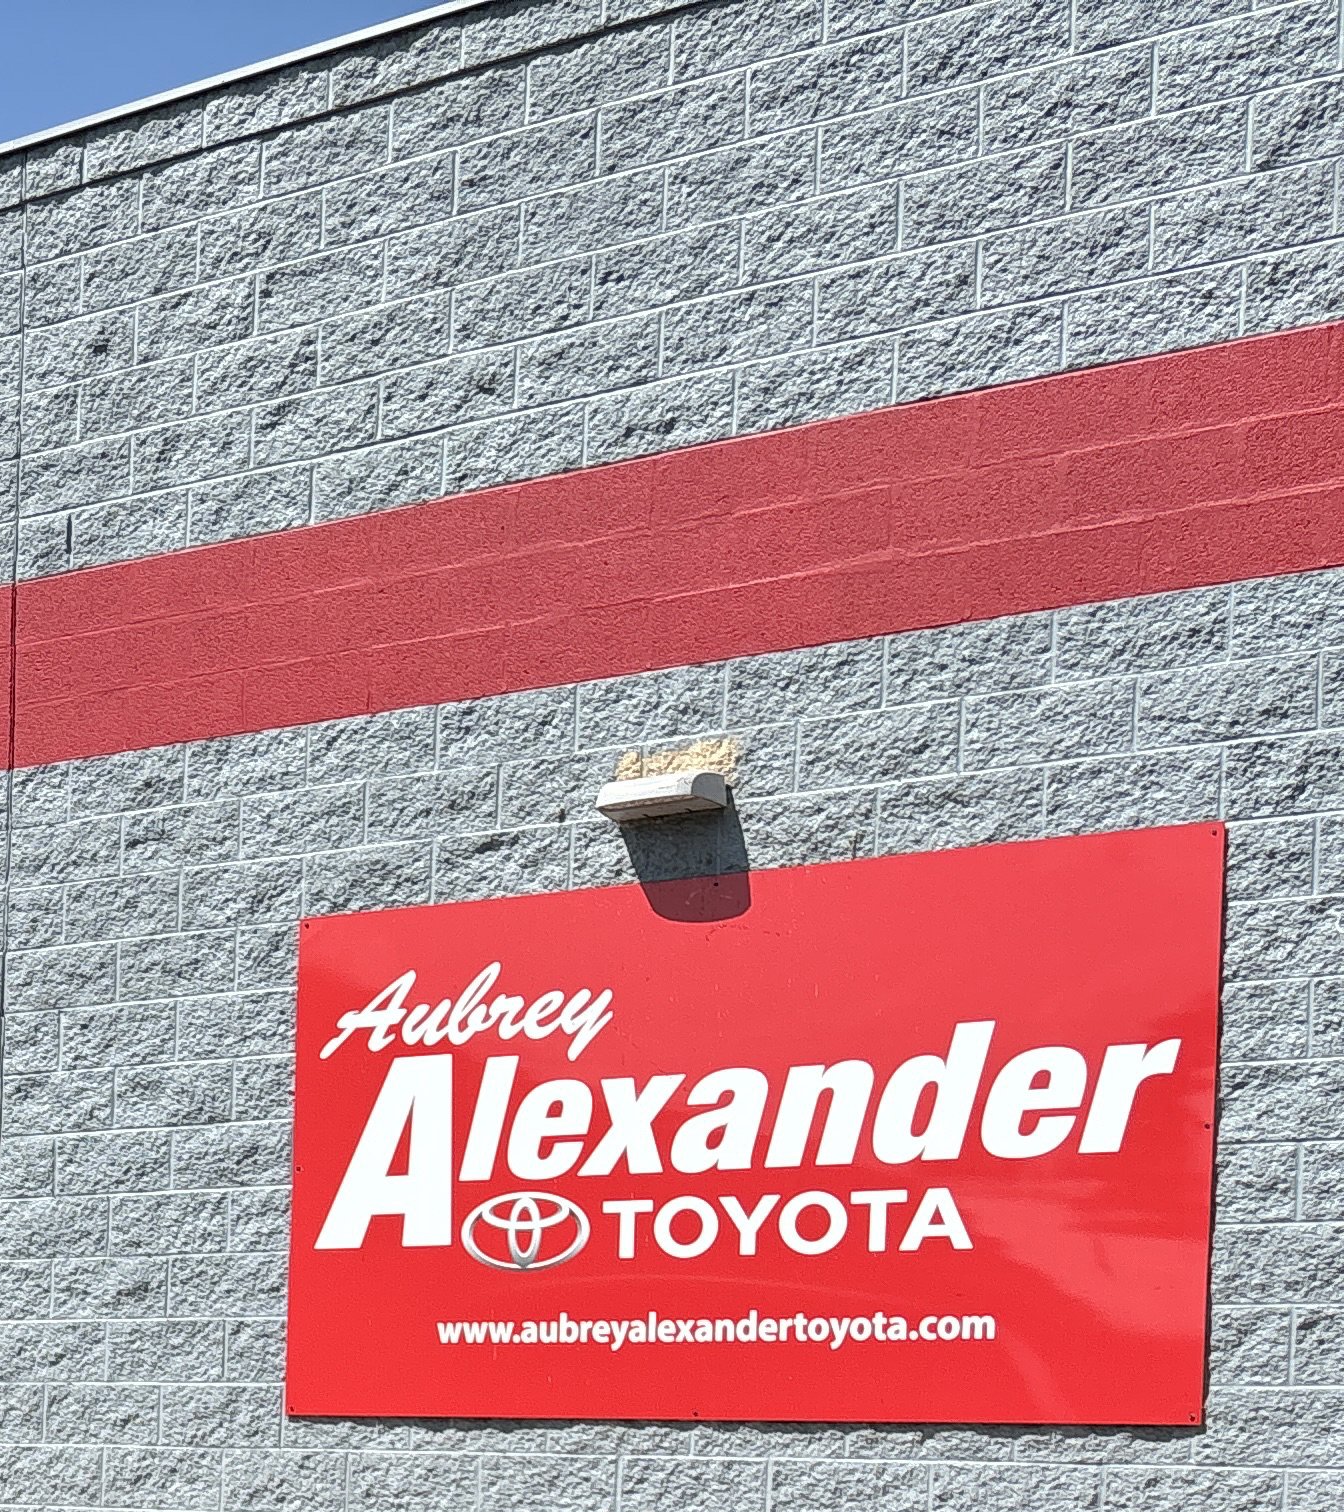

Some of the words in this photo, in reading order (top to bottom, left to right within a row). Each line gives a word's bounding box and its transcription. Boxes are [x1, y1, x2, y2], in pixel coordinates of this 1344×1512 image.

[319, 961, 614, 1062] Aubrey
[313, 1020, 1182, 1250] Alexander
[602, 1187, 974, 1259] TOYOTA
[436, 1309, 996, 1352] www.aubreyalexandertoyota.com
